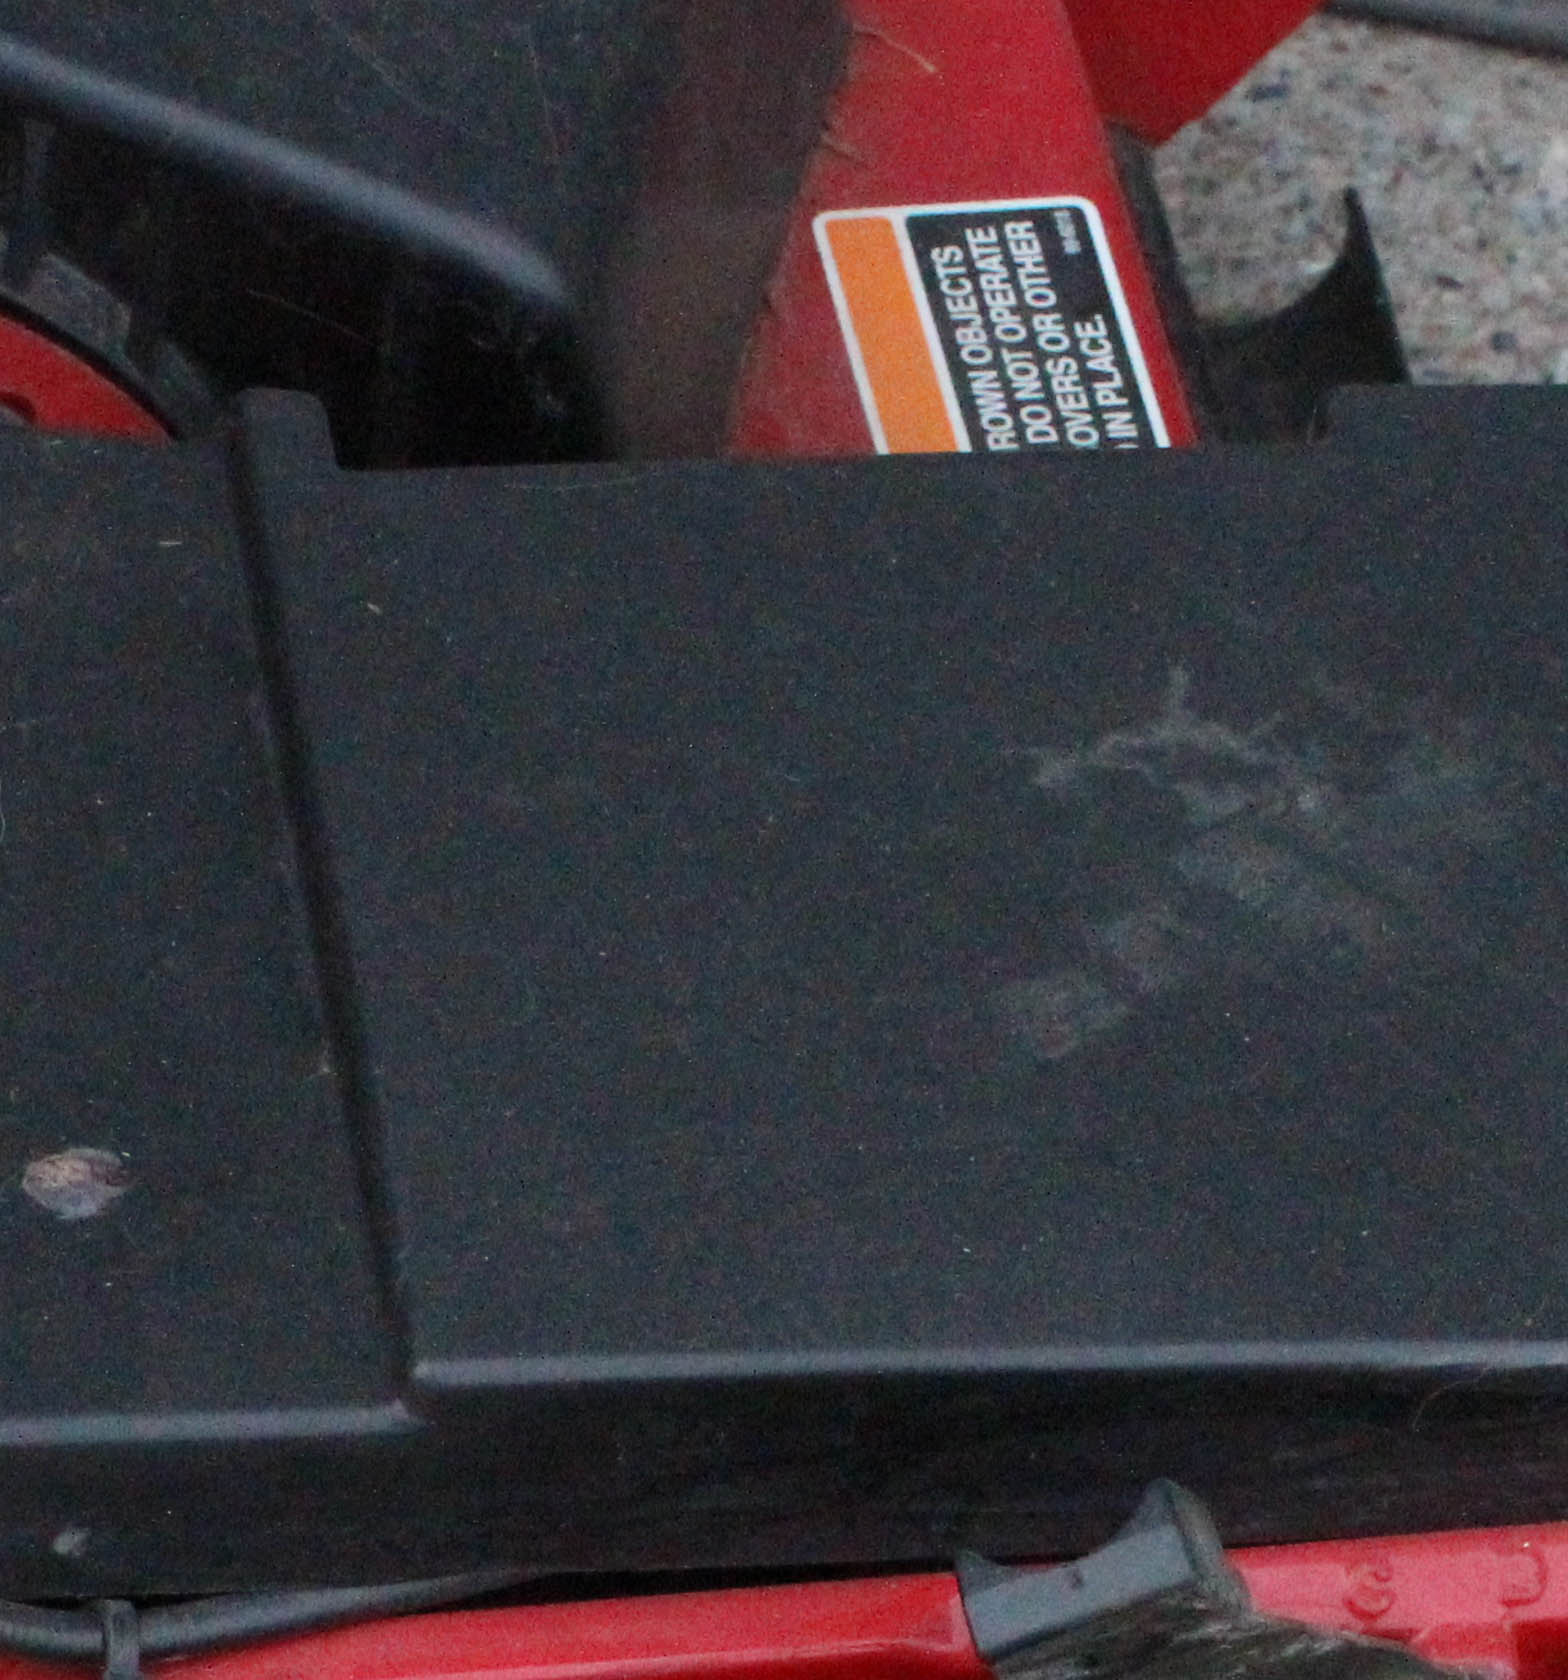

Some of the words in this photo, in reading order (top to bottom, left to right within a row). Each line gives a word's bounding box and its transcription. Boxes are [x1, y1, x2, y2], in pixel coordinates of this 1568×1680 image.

[931, 244, 993, 366] OBJECTS
[965, 225, 1027, 344] OPERATE
[1004, 220, 1057, 309] OTHER
[1000, 348, 1045, 400] NOT
[1033, 313, 1071, 353] OR
[1074, 313, 1128, 408] PLACE.
[967, 370, 1020, 451] ROWN
[1019, 403, 1059, 444] DO
[1046, 356, 1100, 449] OVERS
[1102, 410, 1138, 440] IN
